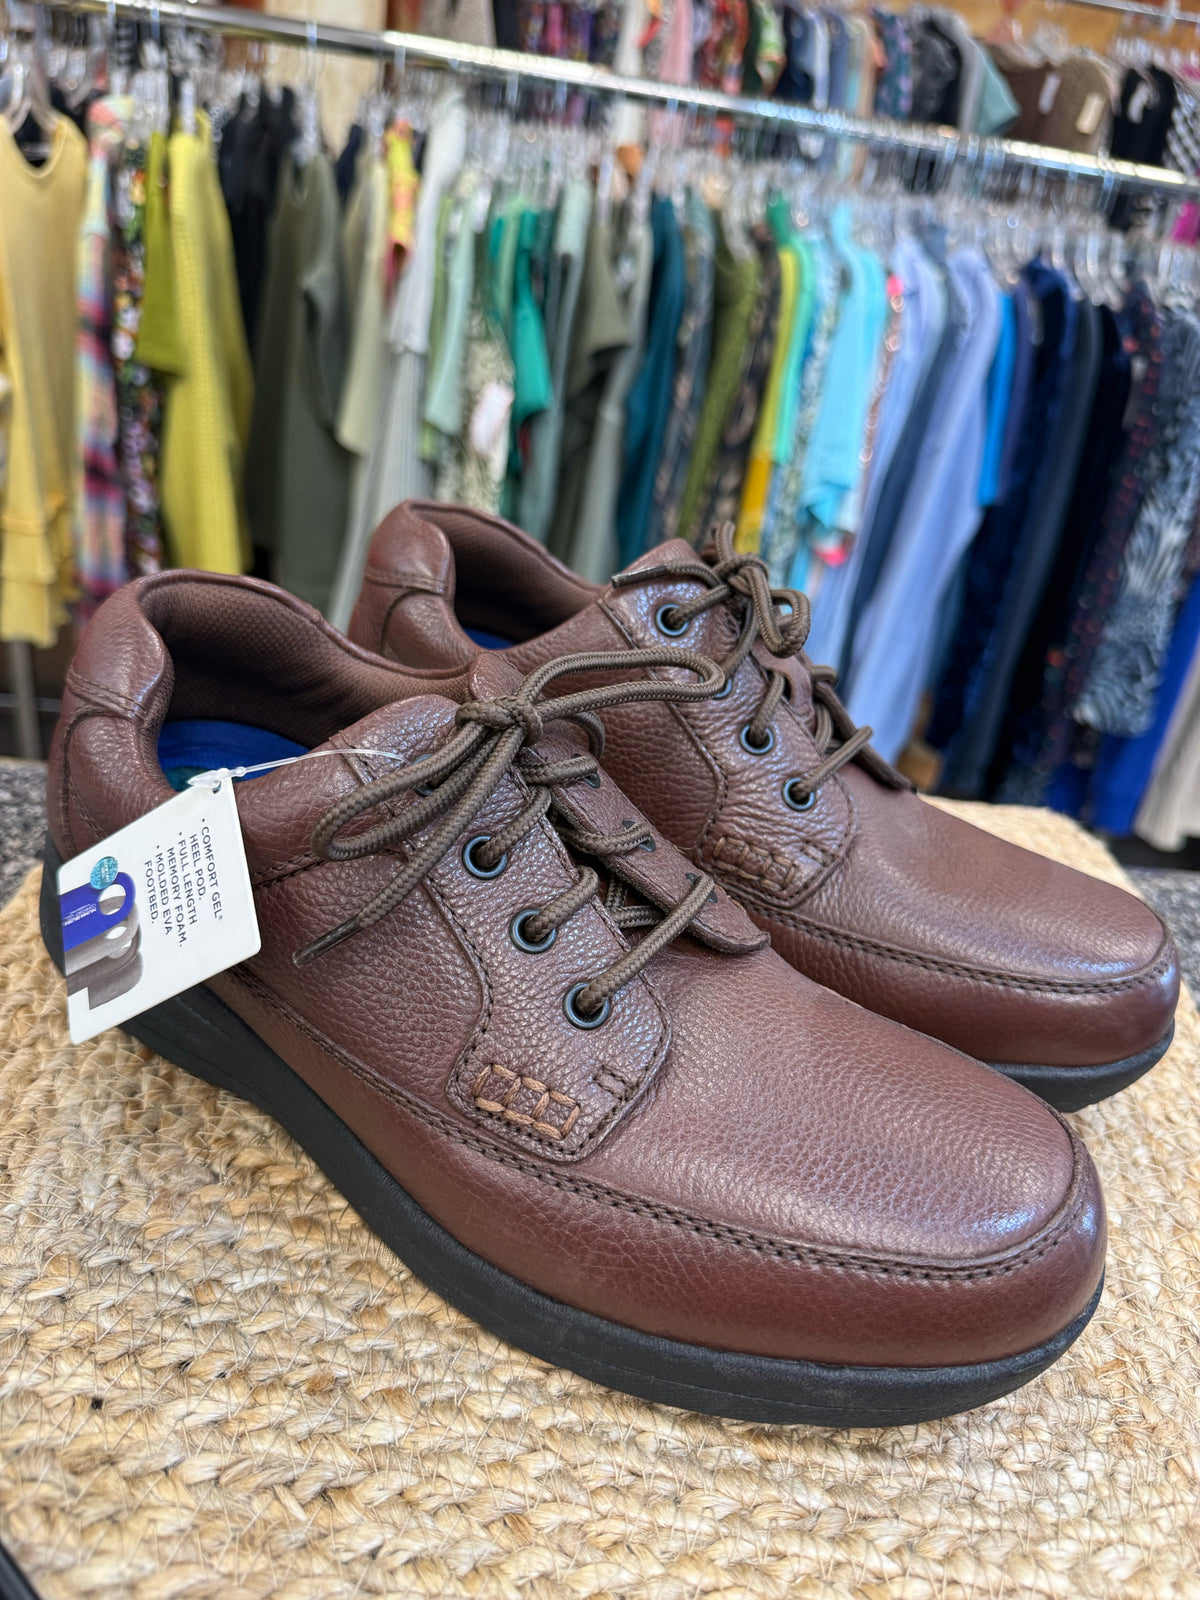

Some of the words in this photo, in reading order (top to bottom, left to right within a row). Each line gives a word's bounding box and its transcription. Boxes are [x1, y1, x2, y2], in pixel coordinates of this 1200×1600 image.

[178, 839, 189, 871] FULL
[190, 833, 201, 867] HEEL
[201, 826, 218, 888] COMFORT
[144, 860, 159, 924] FOOTBED.
[155, 852, 170, 906] MOLDED
[167, 847, 182, 902] MEMORY
[195, 868, 206, 900] POD.
[162, 908, 173, 936] EVA
[183, 873, 198, 925] LENGTH
[174, 904, 187, 948] FOAM.
